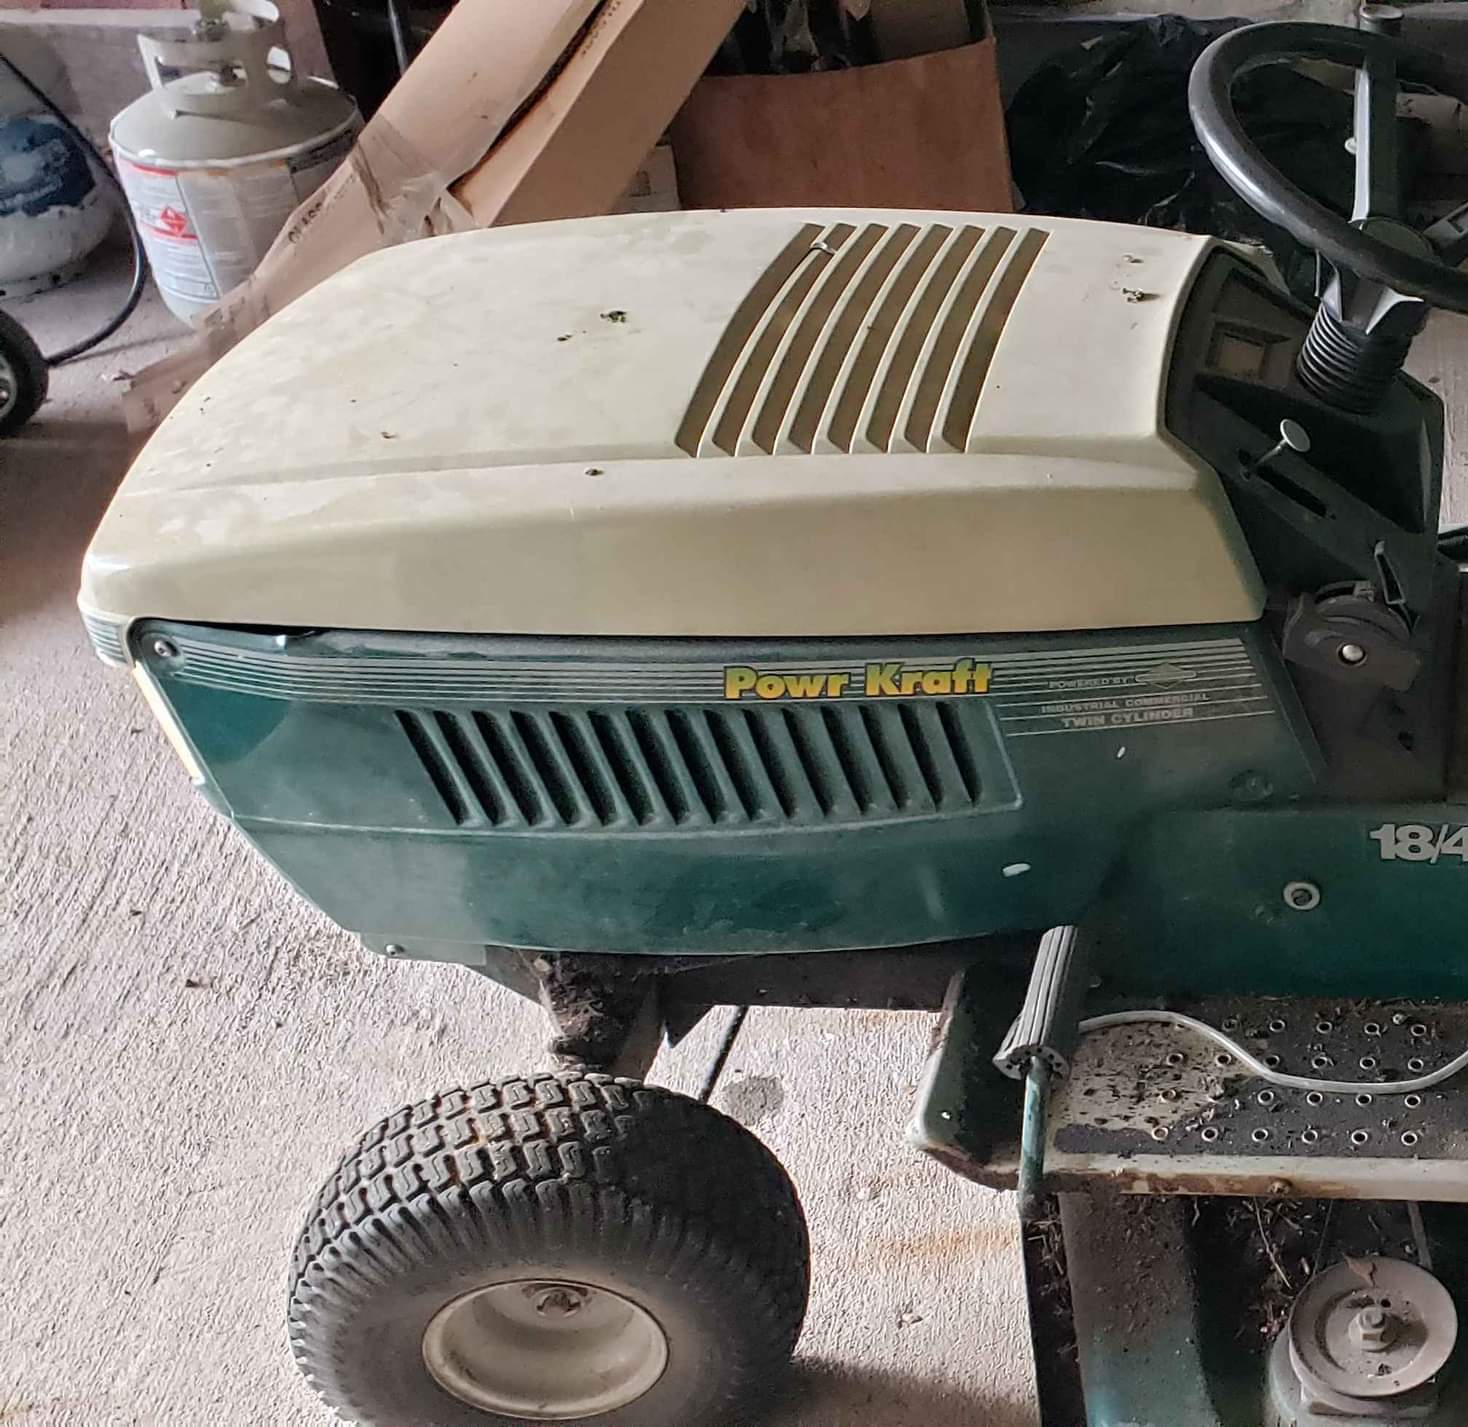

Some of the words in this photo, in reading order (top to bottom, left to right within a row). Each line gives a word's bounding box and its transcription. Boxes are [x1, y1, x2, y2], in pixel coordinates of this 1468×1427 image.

[724, 665, 851, 701] Powr
[863, 657, 993, 699] Kraft
[1041, 700, 1120, 713] INDUSTRIAL
[1125, 693, 1211, 707] COMMERCIAL
[1061, 716, 1105, 728] TWIN
[1111, 707, 1194, 724] CYLINDER
